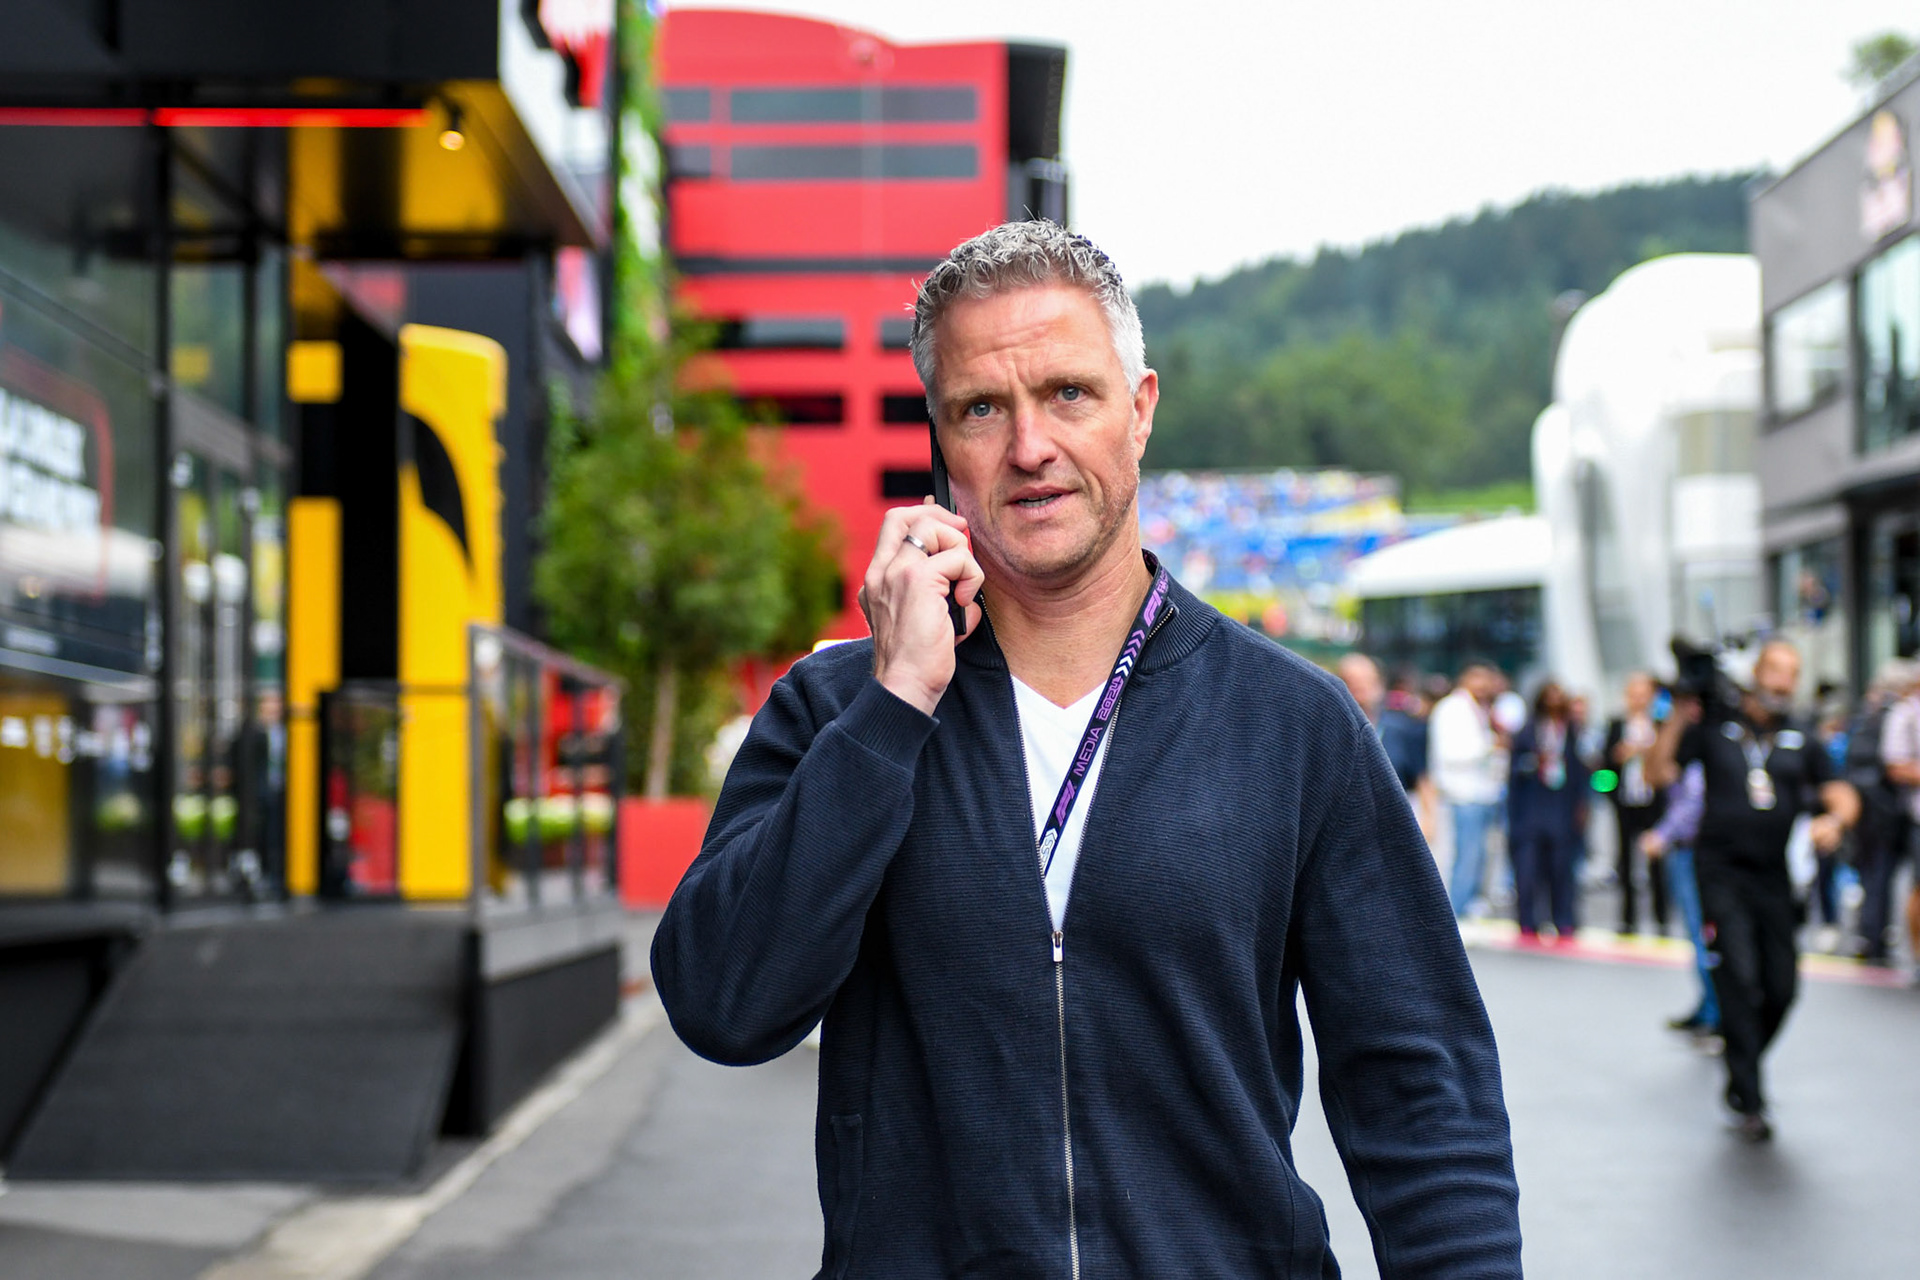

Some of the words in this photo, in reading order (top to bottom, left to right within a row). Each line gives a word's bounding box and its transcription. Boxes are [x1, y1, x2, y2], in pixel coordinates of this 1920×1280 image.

[1055, 779, 1075, 826] F1
[1073, 726, 1102, 777] MEDIA
[1096, 675, 1124, 721] 2024
